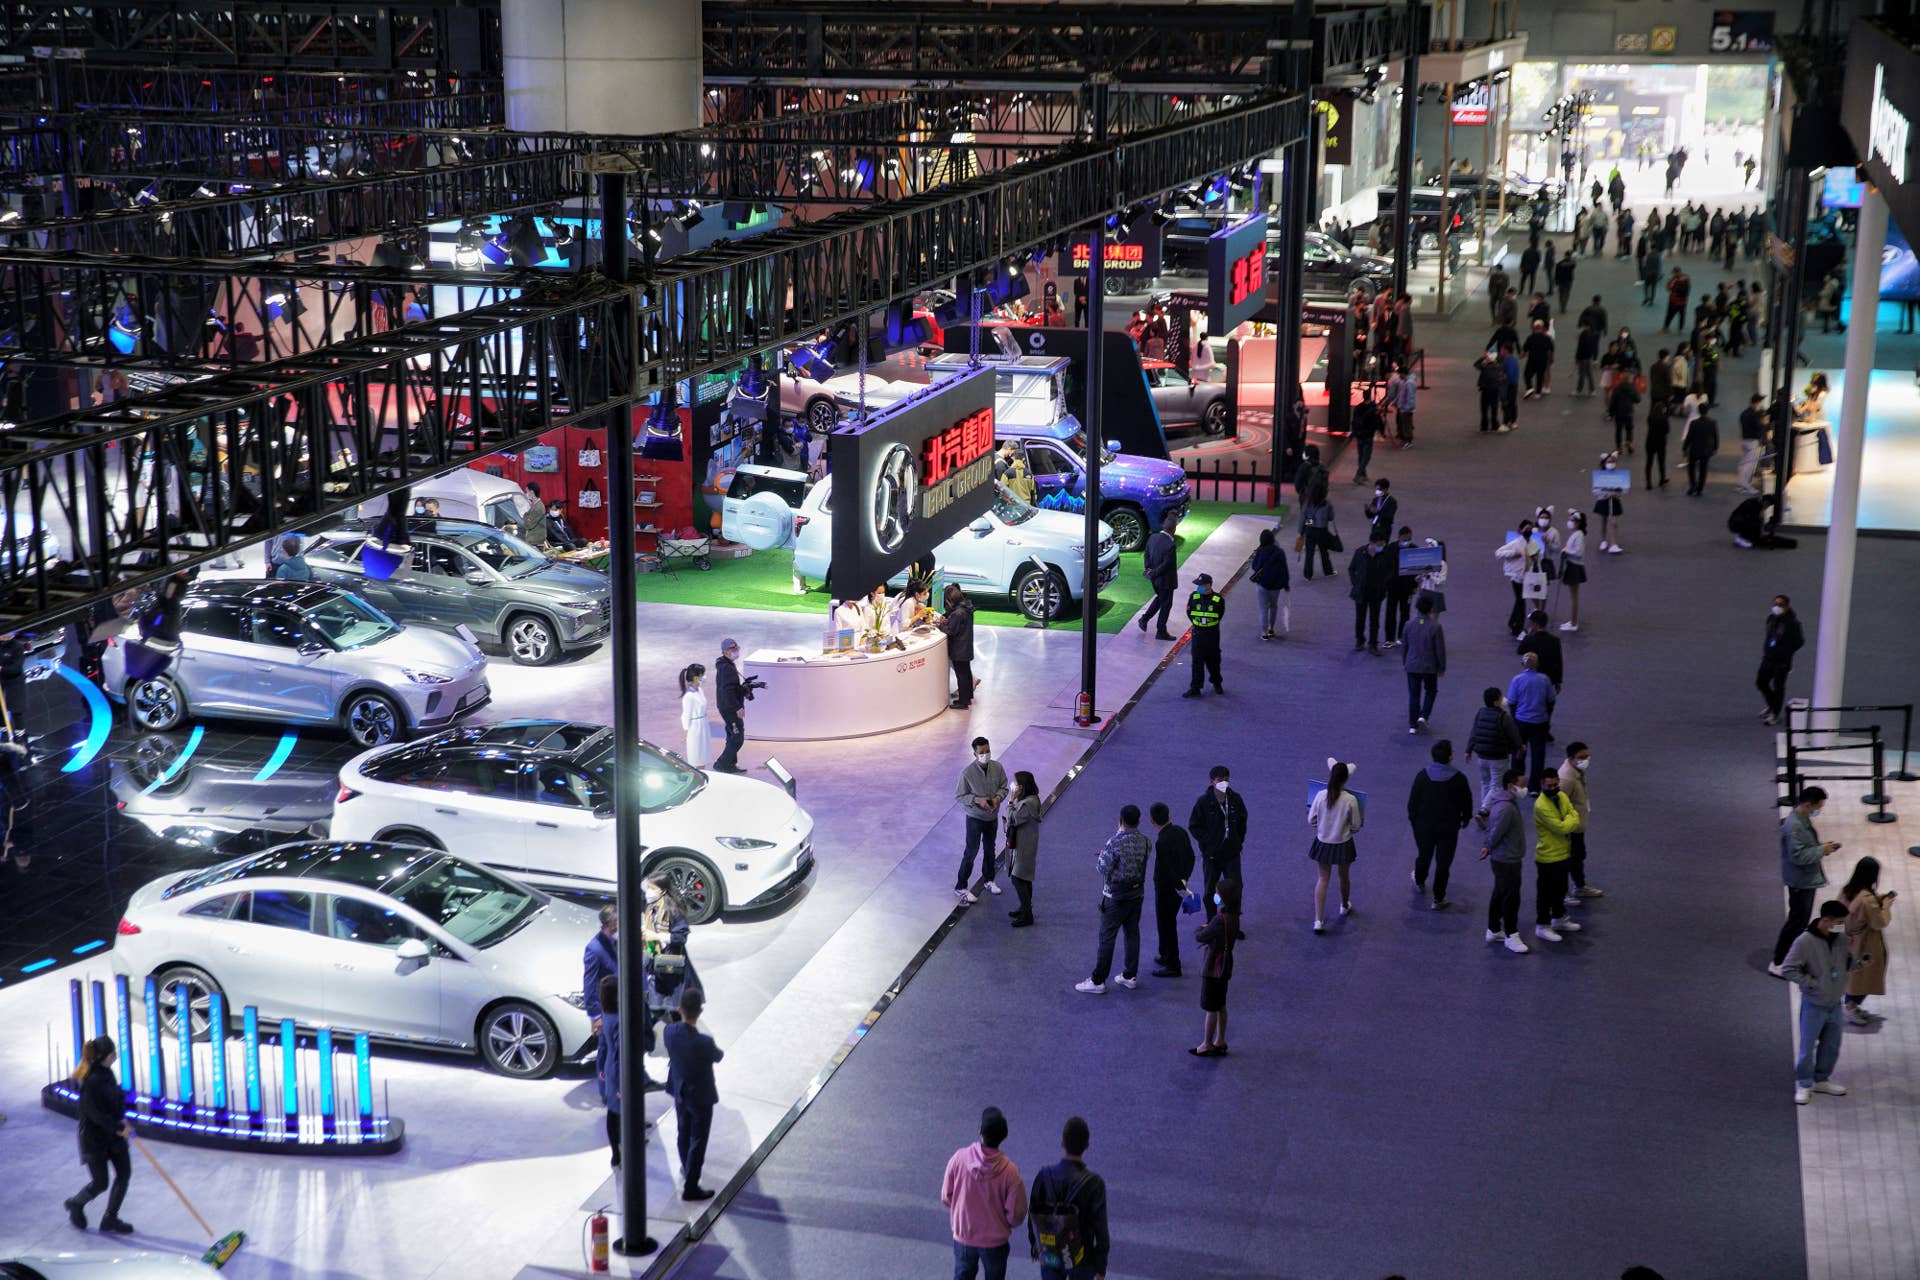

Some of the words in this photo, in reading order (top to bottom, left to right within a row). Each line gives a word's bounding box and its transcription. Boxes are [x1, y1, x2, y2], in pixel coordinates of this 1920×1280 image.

[1073, 244, 1143, 260] 北集团
[1104, 261, 1142, 270] GROUP
[925, 407, 993, 487] 北汽集团
[923, 478, 954, 518] BAIC
[956, 456, 992, 498] GROUP
